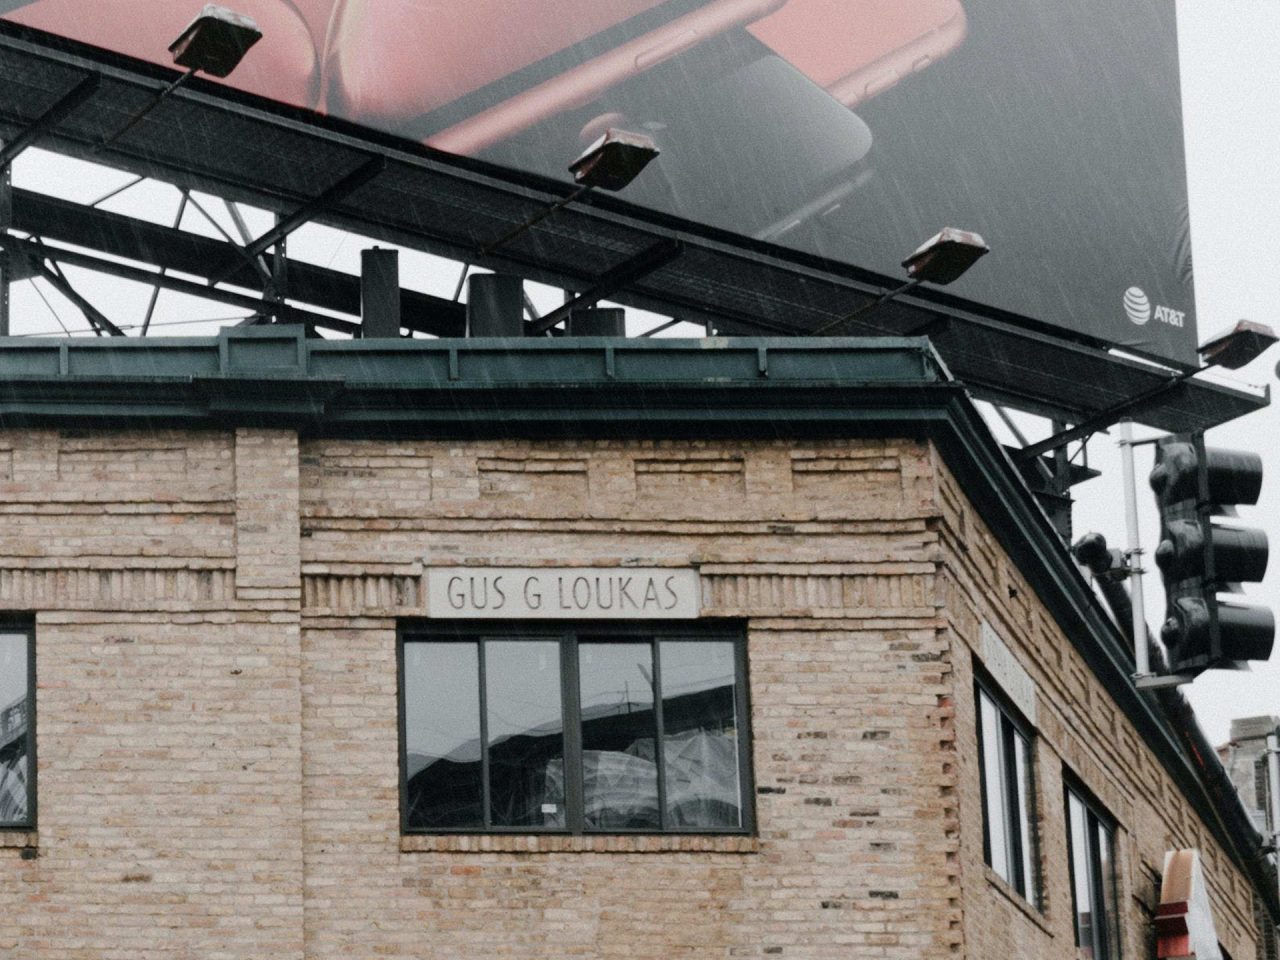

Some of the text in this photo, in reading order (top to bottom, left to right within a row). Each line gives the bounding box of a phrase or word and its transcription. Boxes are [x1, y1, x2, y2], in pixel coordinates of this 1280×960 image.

[1154, 305, 1185, 327] AT&T
[447, 576, 679, 610] GUS G LOUKAS
